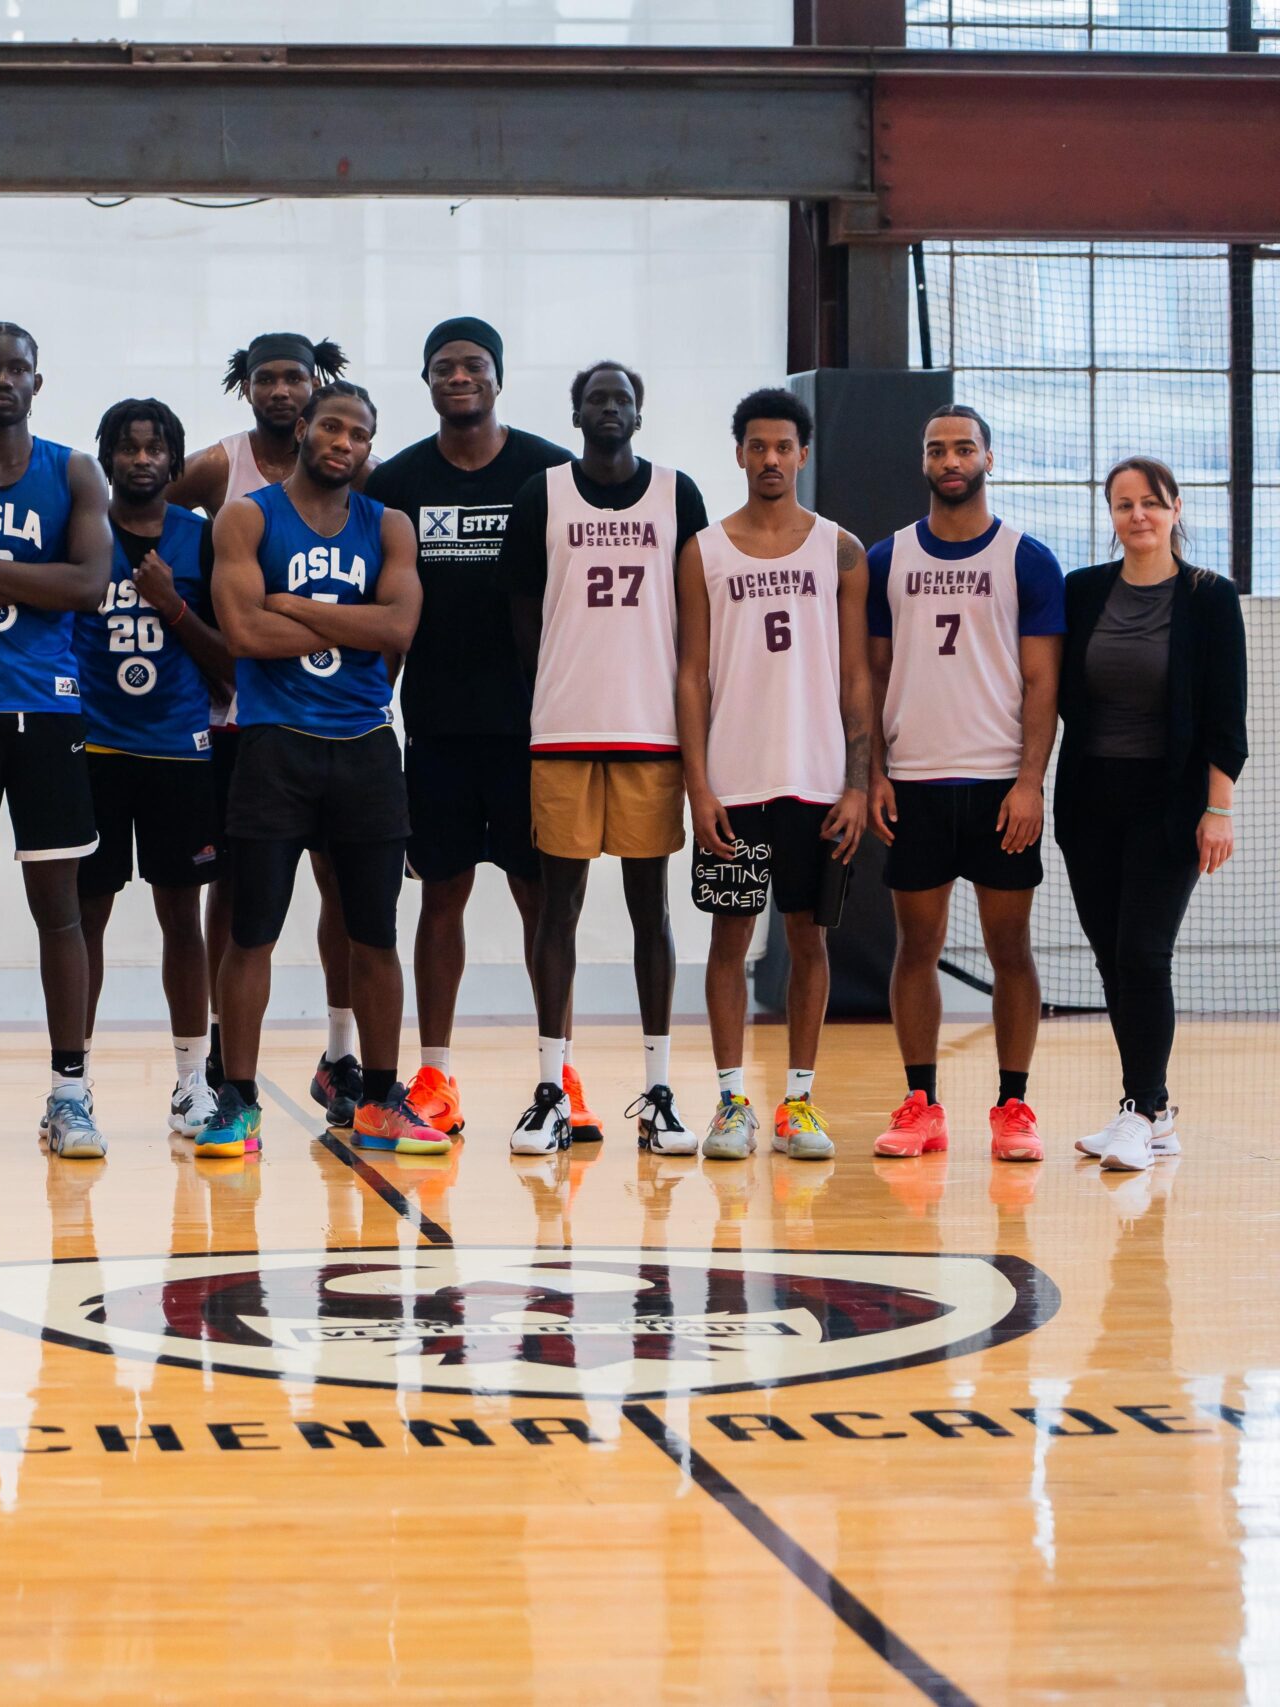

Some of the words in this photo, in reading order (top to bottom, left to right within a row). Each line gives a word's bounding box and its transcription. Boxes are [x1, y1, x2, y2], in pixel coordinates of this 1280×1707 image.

[425, 510, 453, 538] X
[463, 514, 509, 533] STFX
[567, 521, 659, 549] UCHENNA
[587, 537, 640, 547] SELECT
[288, 546, 366, 595] QSLA
[906, 570, 992, 597] UCHENNA
[98, 579, 157, 616] QS
[587, 566, 645, 608] 27
[727, 570, 817, 603] UCHENNA
[748, 585, 800, 598] SELECT
[923, 585, 974, 595] SELECT
[107, 615, 163, 652] 20
[764, 610, 792, 653] 6
[935, 613, 961, 655] 7
[696, 864, 769, 883] GETTING
[697, 884, 766, 908] BUCKETS
